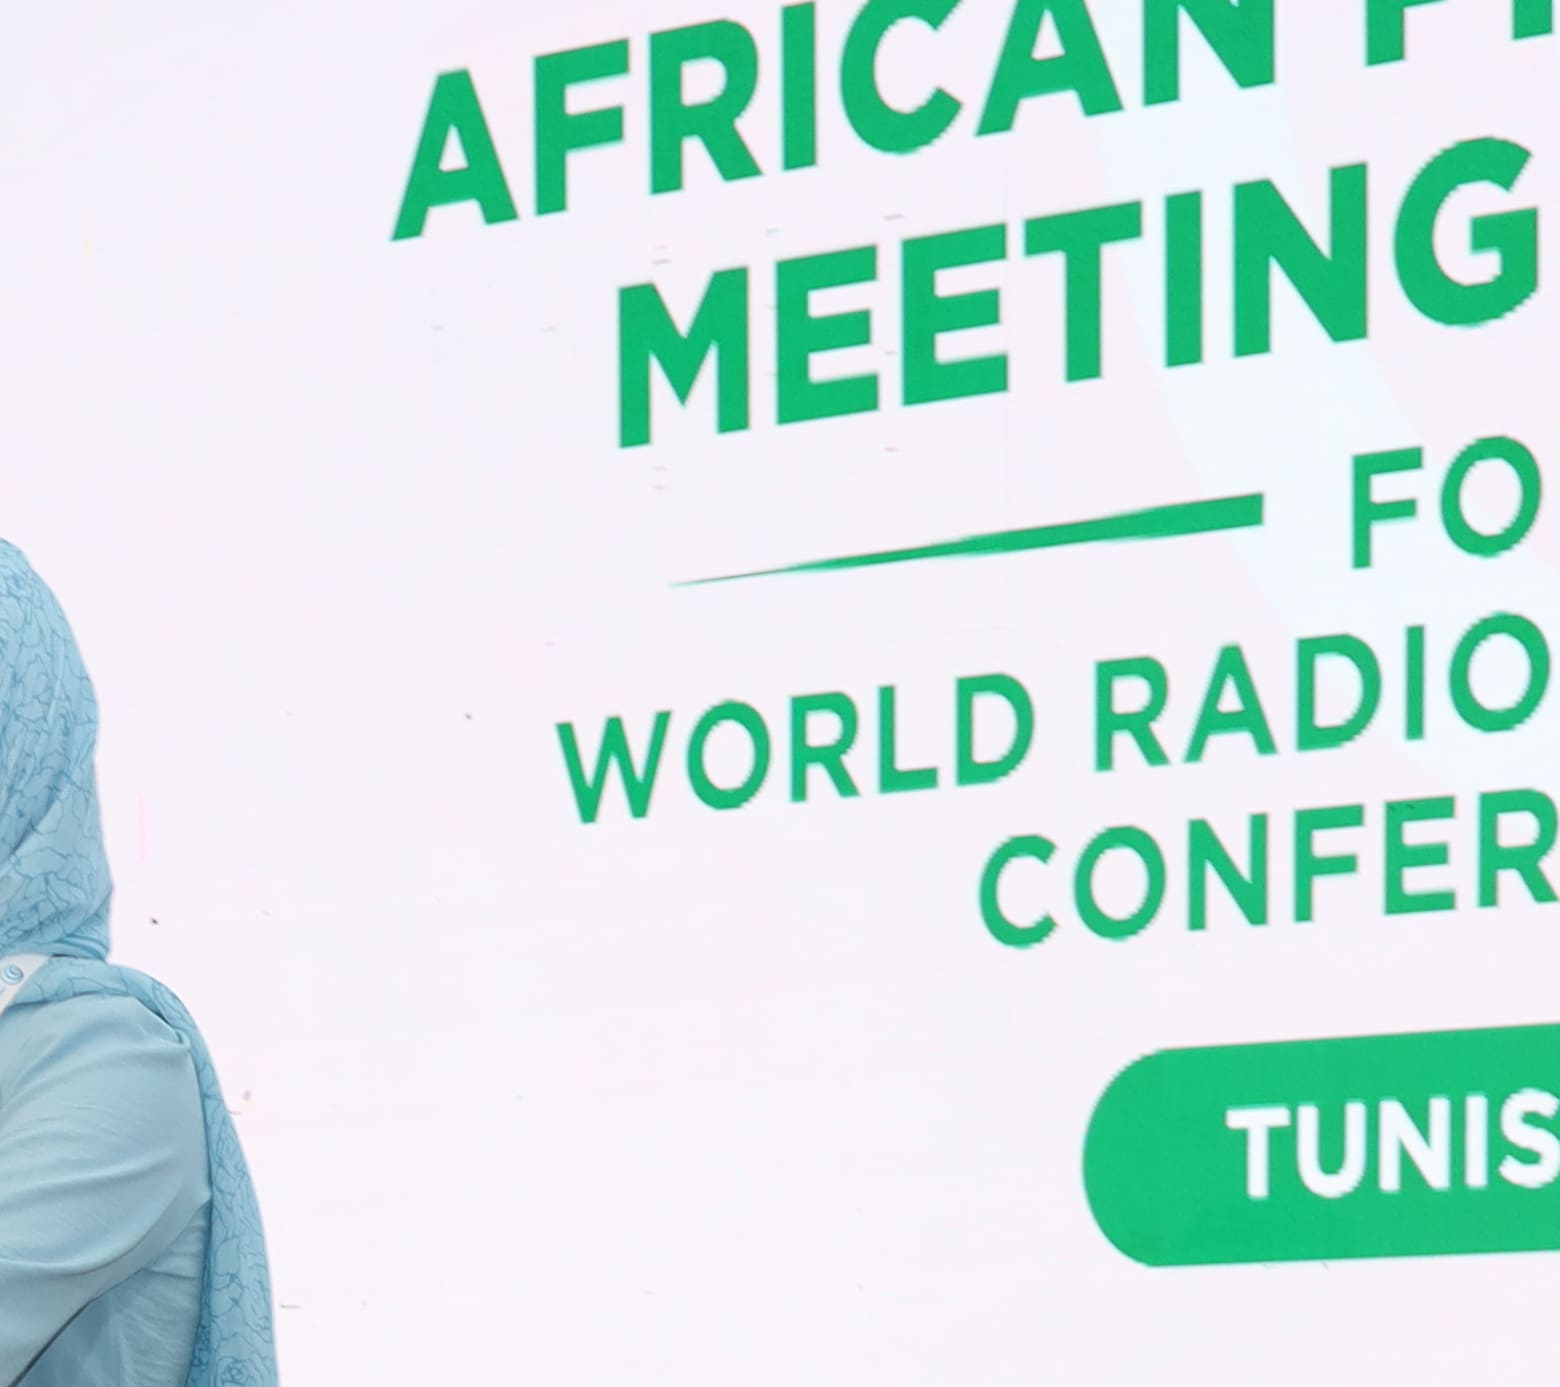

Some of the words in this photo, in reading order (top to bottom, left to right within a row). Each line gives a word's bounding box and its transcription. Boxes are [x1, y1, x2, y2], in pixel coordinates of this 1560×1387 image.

[388, 0, 1276, 243] AFRICAN
[615, 136, 1539, 451] MEETING
[553, 672, 1035, 826] WORLD
